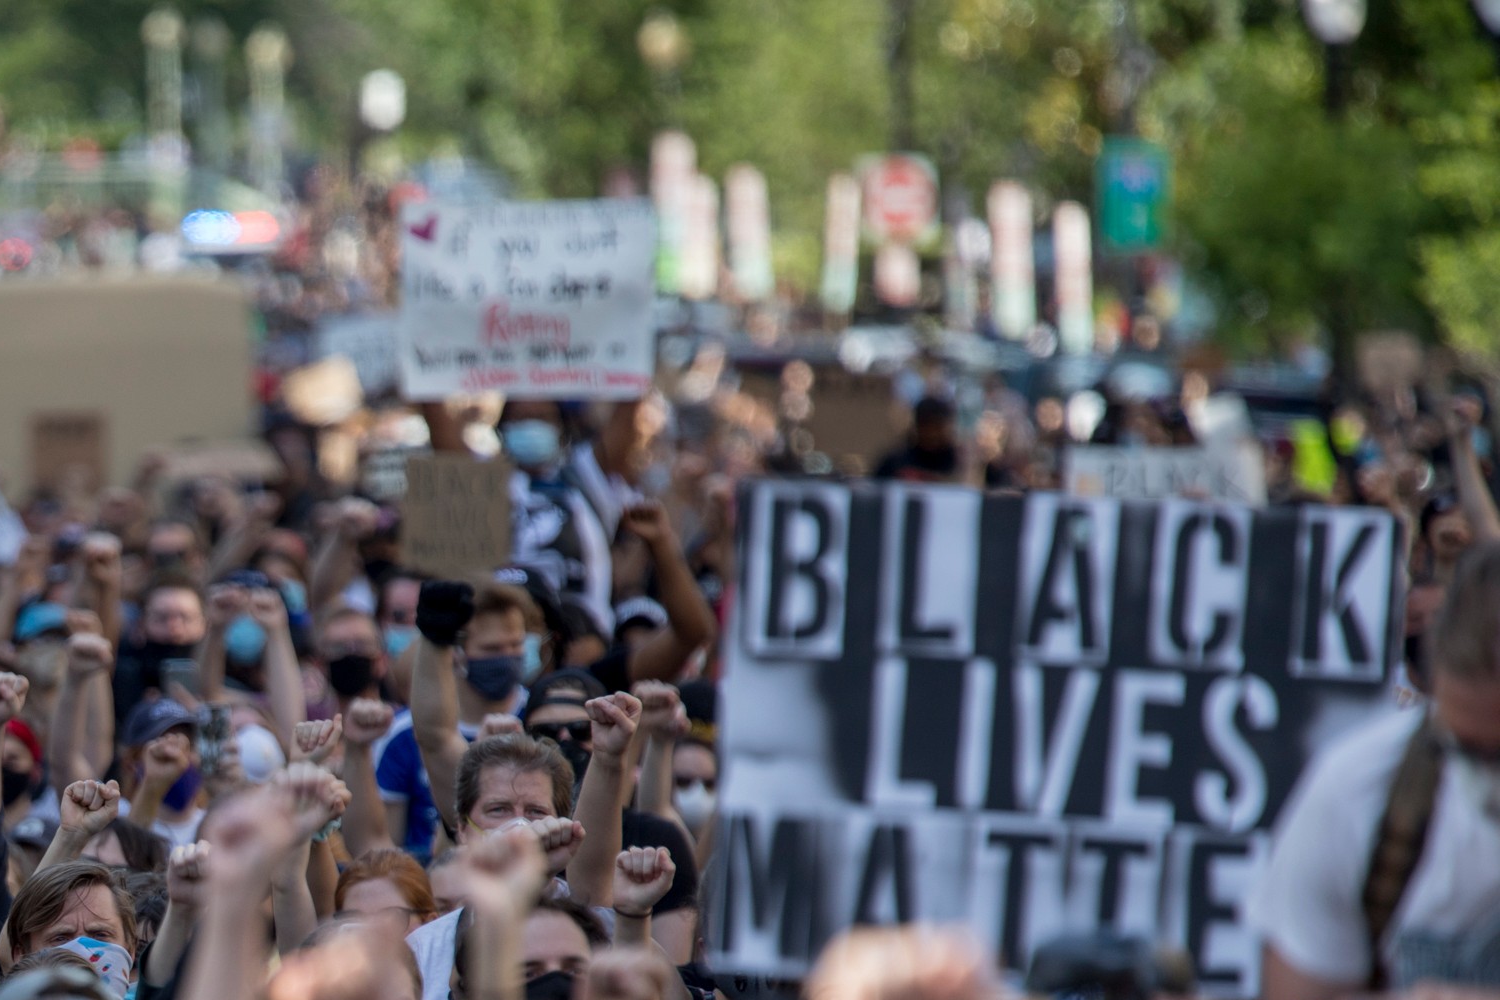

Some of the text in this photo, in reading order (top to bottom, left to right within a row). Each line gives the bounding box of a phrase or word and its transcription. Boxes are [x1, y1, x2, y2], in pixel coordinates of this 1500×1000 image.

[765, 490, 1387, 664] BLACK
[863, 657, 1280, 834] LIVES
[722, 816, 1255, 987] MATTE
